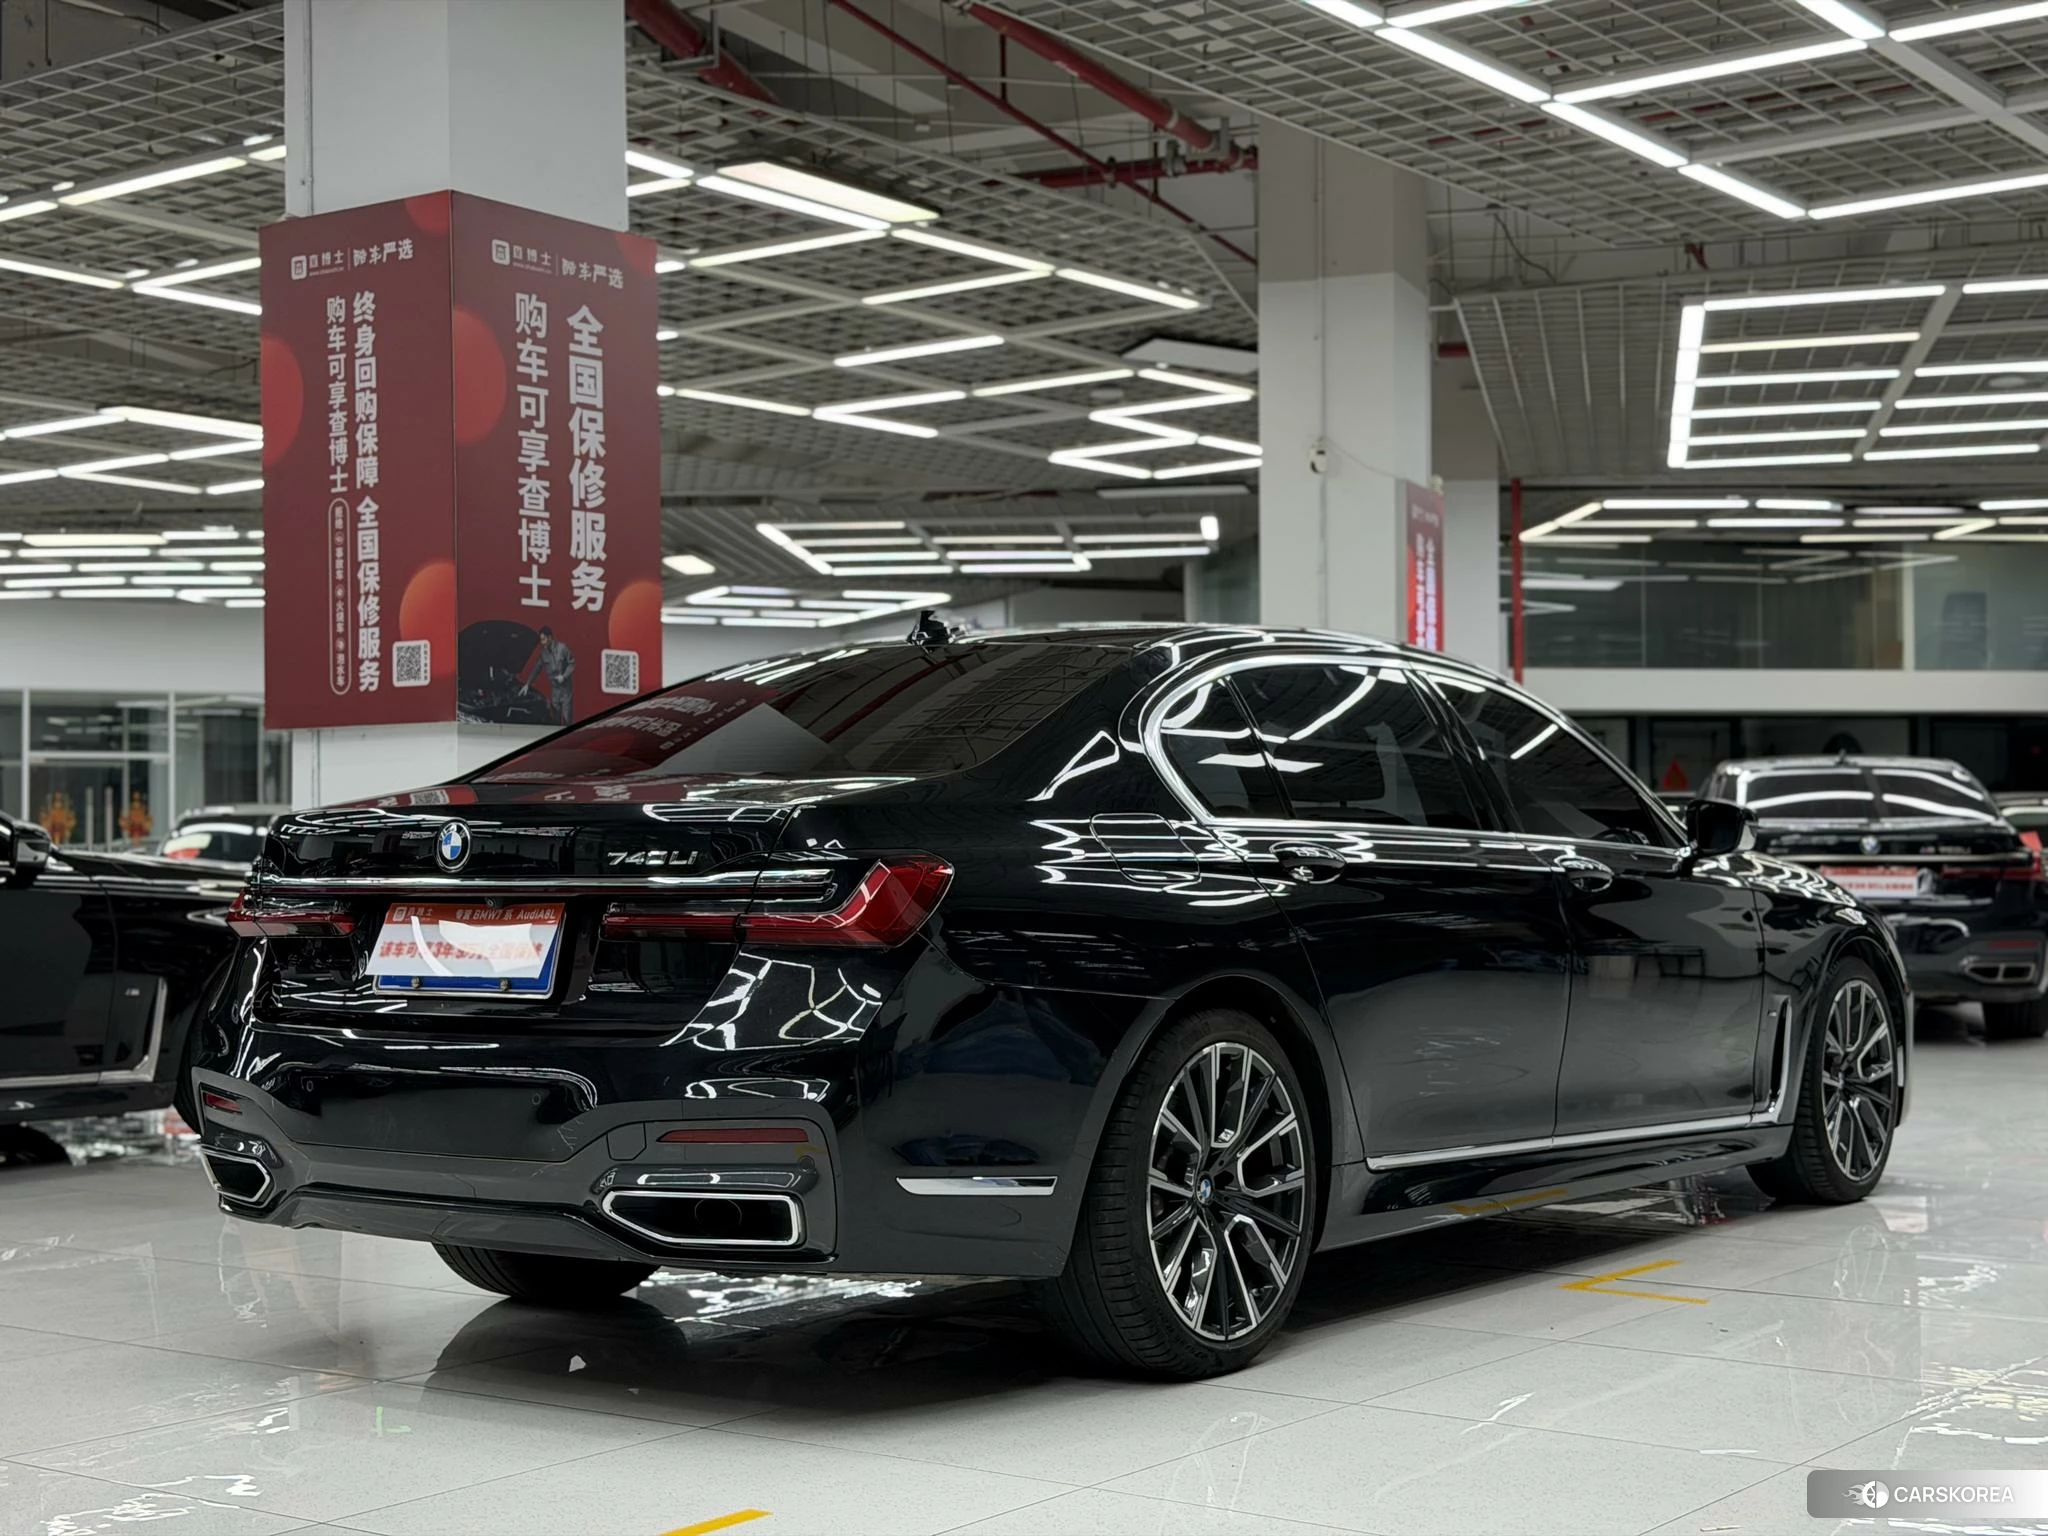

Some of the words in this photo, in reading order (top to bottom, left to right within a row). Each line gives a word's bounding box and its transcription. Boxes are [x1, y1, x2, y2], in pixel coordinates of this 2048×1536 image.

[326, 296, 349, 494] 购车可享查博士
[353, 291, 379, 489] 终身回购保障
[515, 292, 551, 608] 购车可享查博士
[566, 304, 607, 613] 全国保修服务
[356, 495, 381, 693] 全国保修服务
